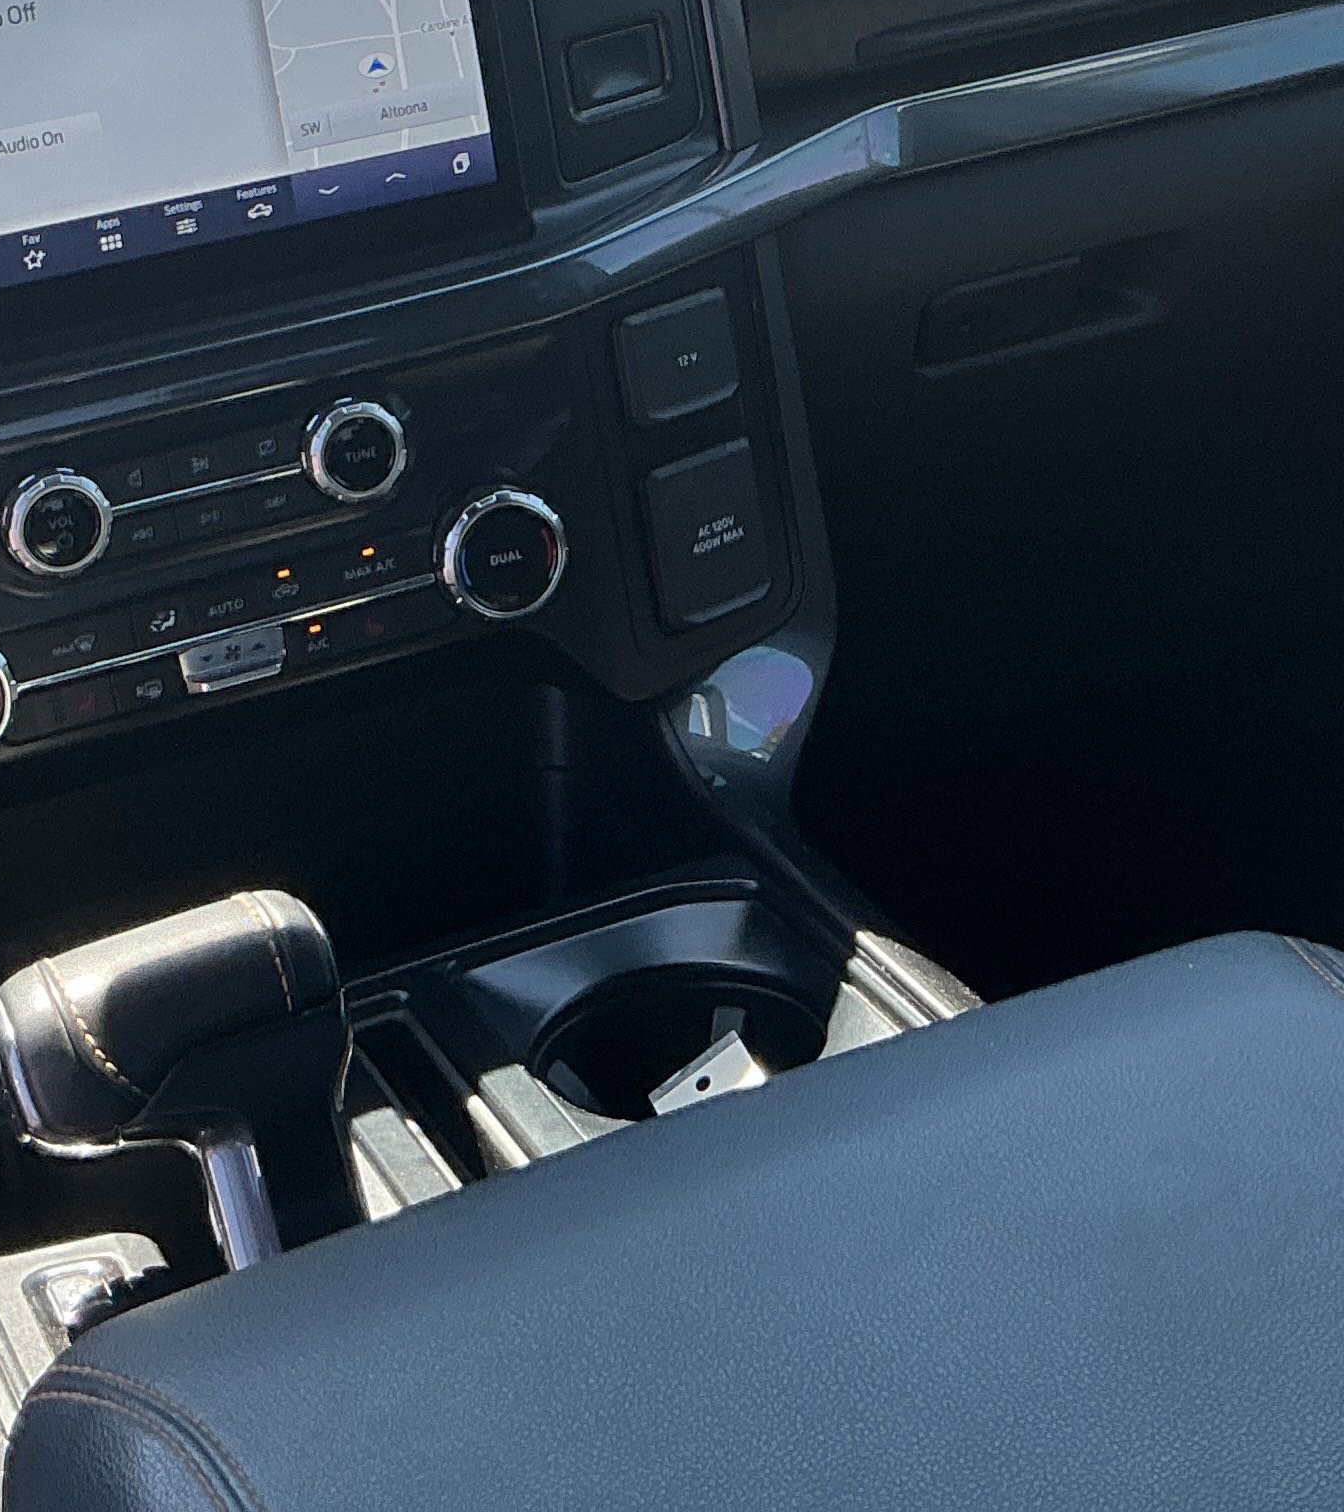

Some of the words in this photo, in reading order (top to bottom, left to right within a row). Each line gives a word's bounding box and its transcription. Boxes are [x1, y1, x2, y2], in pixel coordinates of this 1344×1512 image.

[7, 1, 37, 26] Off
[379, 100, 428, 121] Altoona
[300, 120, 321, 137] SW
[42, 130, 64, 148] On
[236, 184, 278, 202] Features
[163, 199, 204, 217] Settings
[95, 217, 121, 231] Apps
[22, 233, 42, 247] Fav
[47, 514, 76, 531] VOL
[489, 548, 524, 567] DUAL
[208, 597, 247, 618] AUTO
